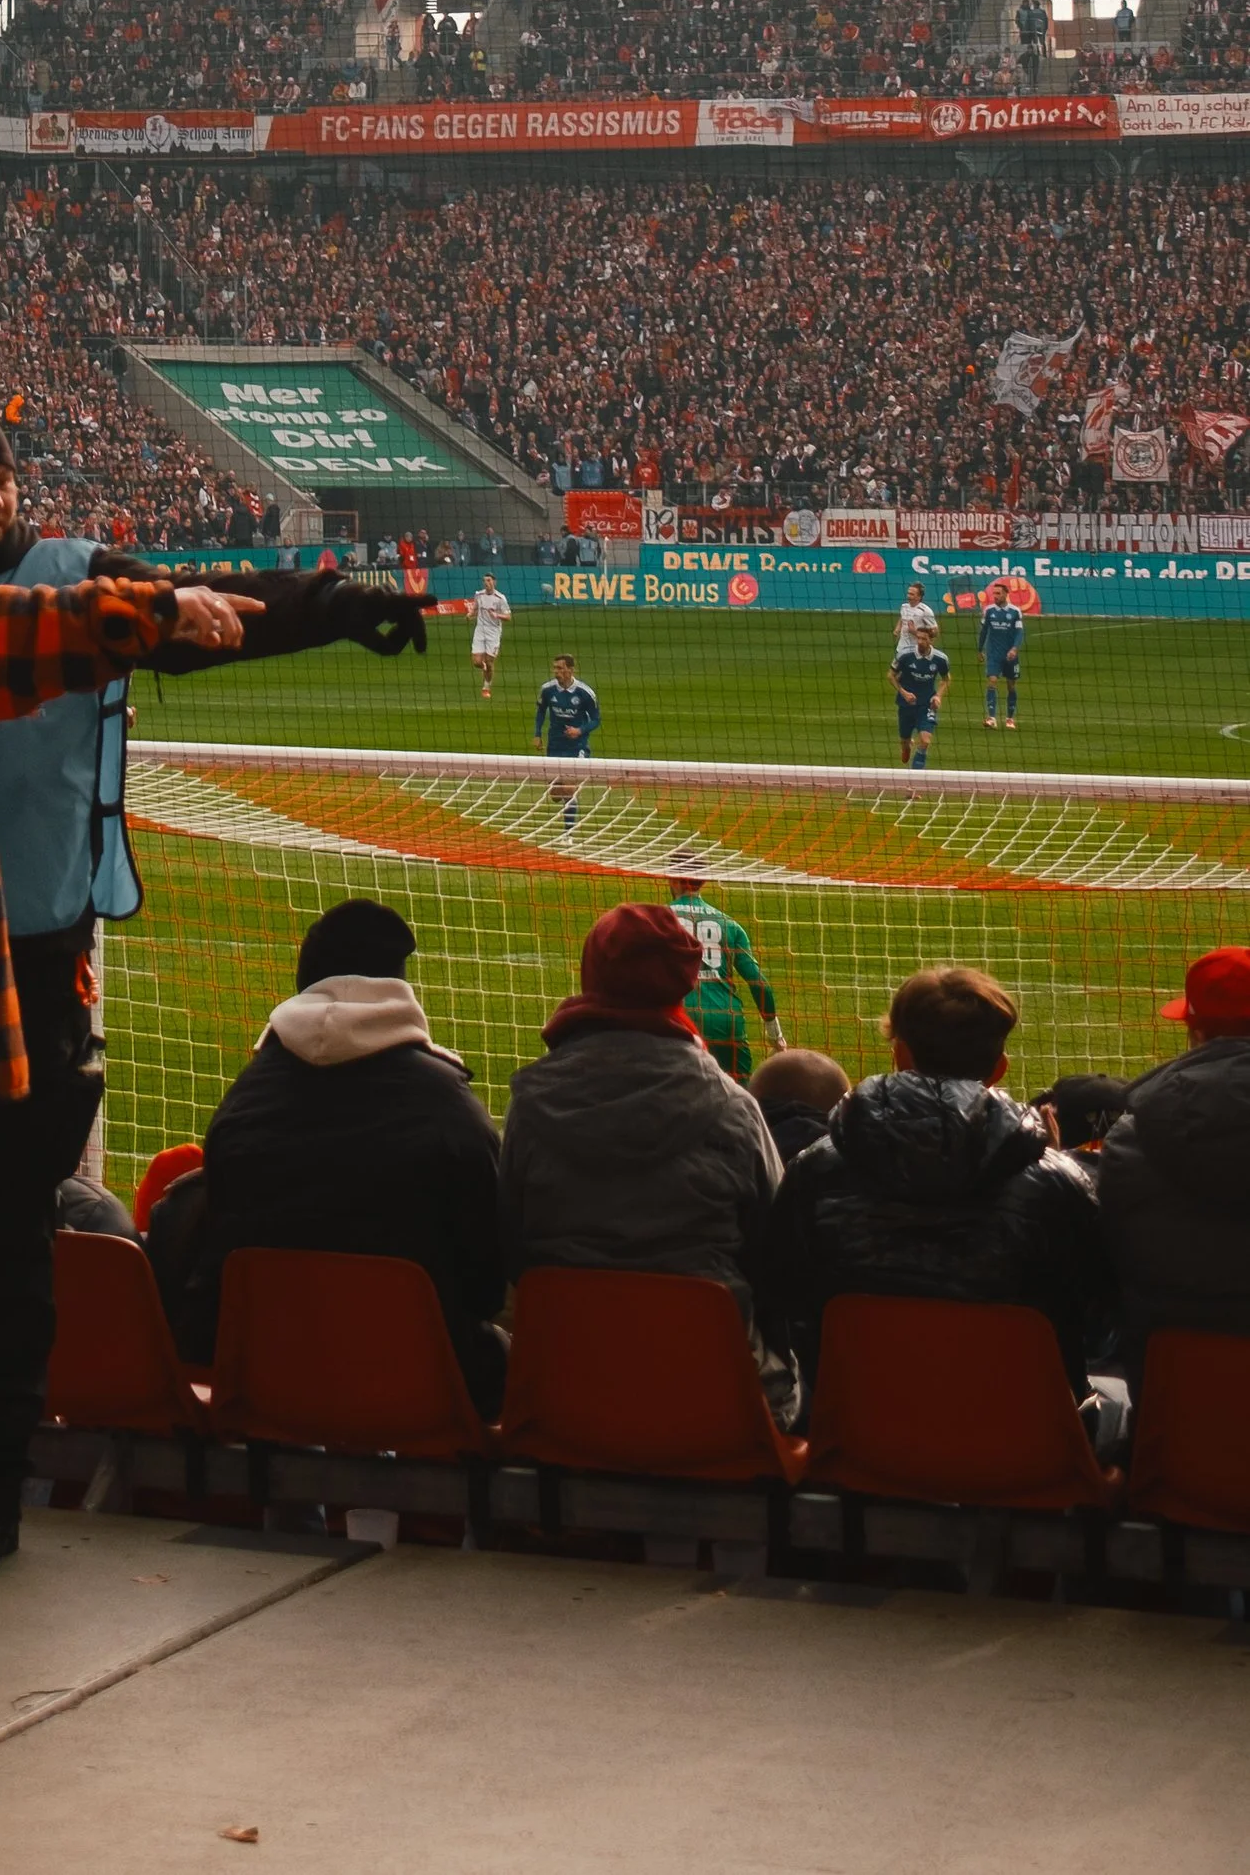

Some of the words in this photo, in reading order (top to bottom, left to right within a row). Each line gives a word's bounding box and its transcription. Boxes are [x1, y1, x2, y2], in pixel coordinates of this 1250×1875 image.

[820, 110, 922, 124] GEROLSTEIN
[1126, 98, 1150, 113] Am
[1174, 99, 1200, 119] Tag
[321, 114, 425, 142] FC-FANS
[433, 112, 518, 140] GEGEN
[527, 109, 681, 137] RASSISMUS
[1122, 118, 1152, 132] Gott
[1157, 117, 1182, 132] den
[1200, 116, 1217, 130] FC
[122, 126, 145, 142] Old
[177, 126, 218, 142] School
[221, 126, 252, 142] Army
[220, 382, 324, 405] Mer
[205, 406, 332, 425] stonn
[336, 407, 388, 424] zo
[270, 428, 377, 449] Dir!
[270, 456, 450, 473] DEVK
[826, 518, 889, 538] CRICCAA
[908, 531, 960, 549] STADION
[554, 572, 636, 602] REWE
[644, 574, 719, 603] Bonus
